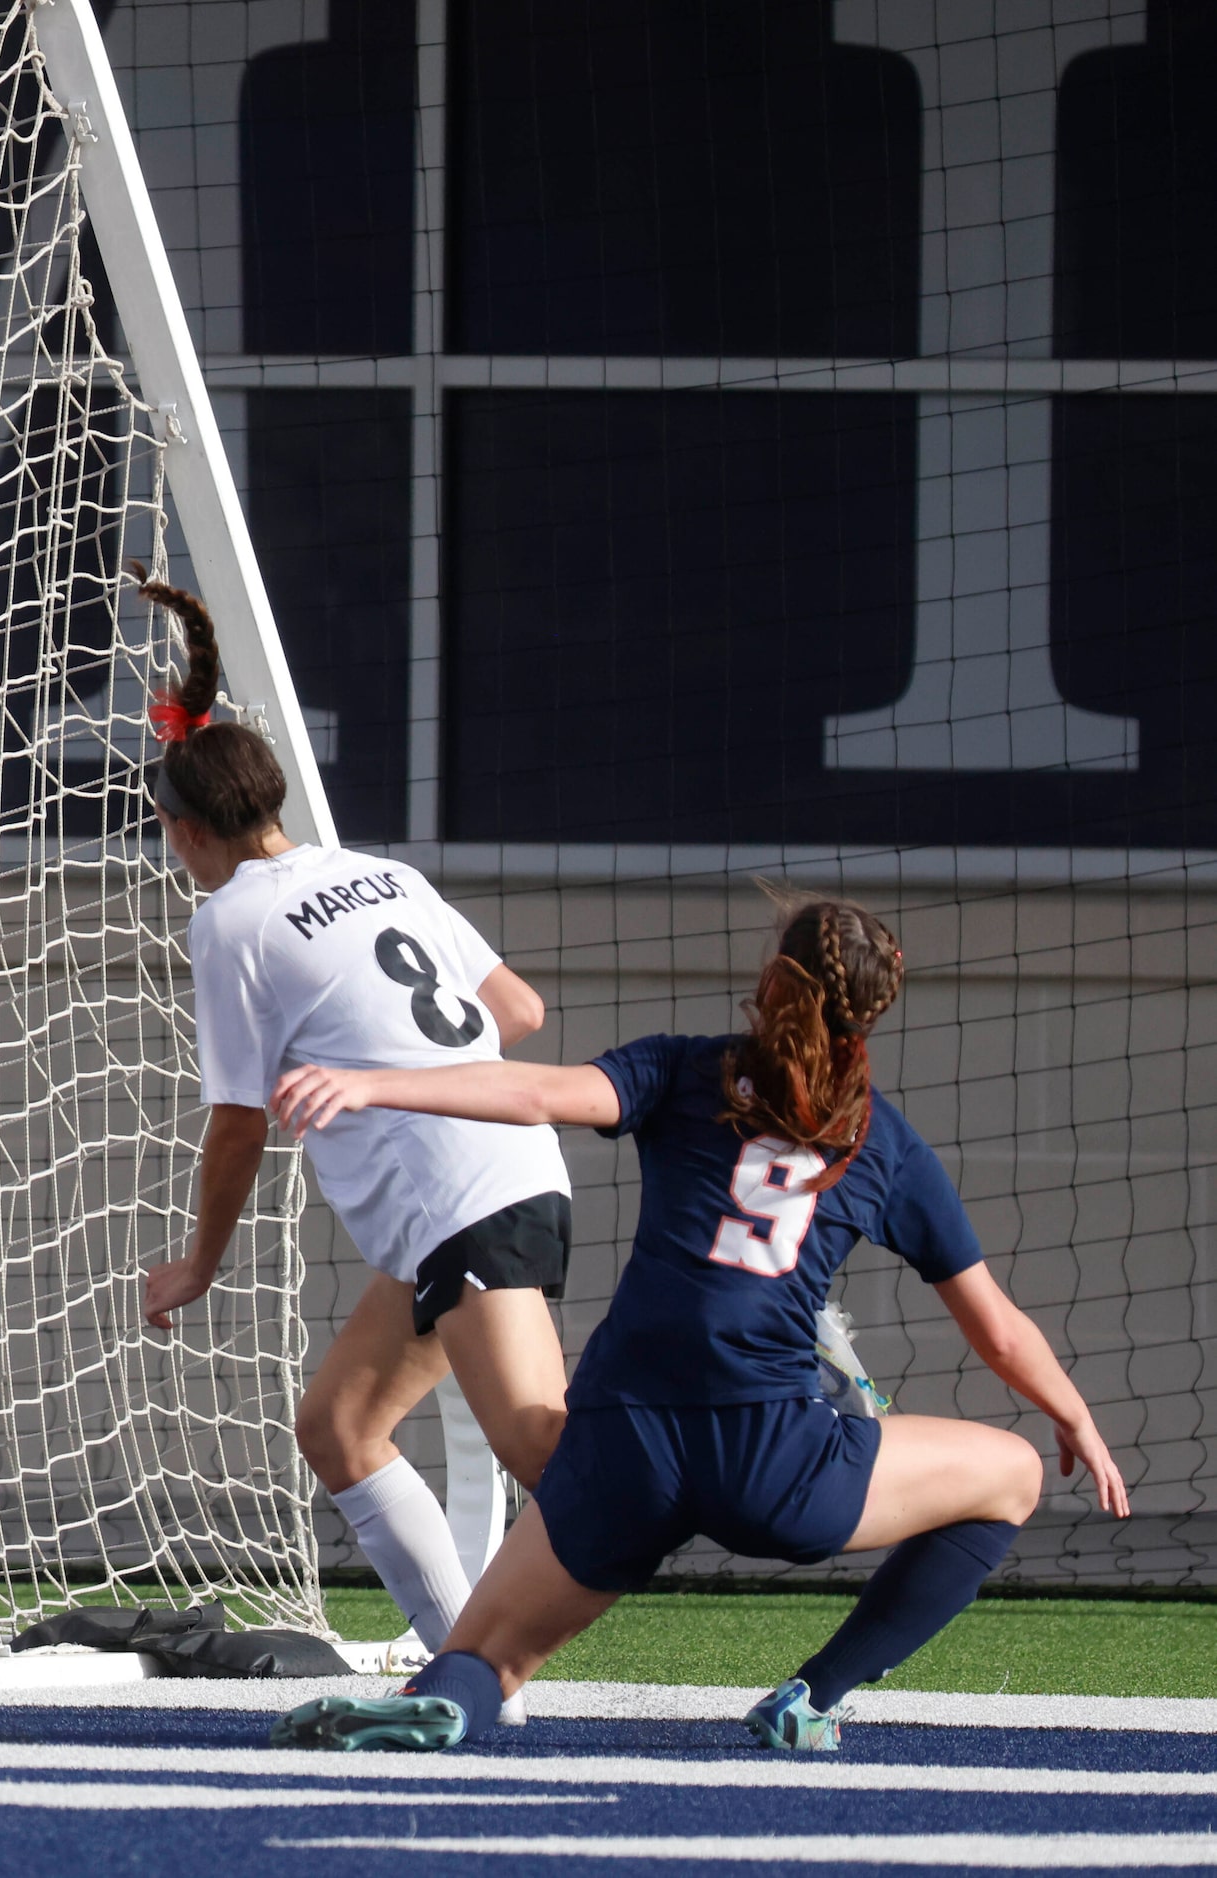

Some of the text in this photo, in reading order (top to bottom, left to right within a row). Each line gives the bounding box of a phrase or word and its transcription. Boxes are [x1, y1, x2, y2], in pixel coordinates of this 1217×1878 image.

[285, 871, 409, 941] MARCUS
[374, 926, 484, 1048] 8
[708, 1133, 827, 1279] 9
